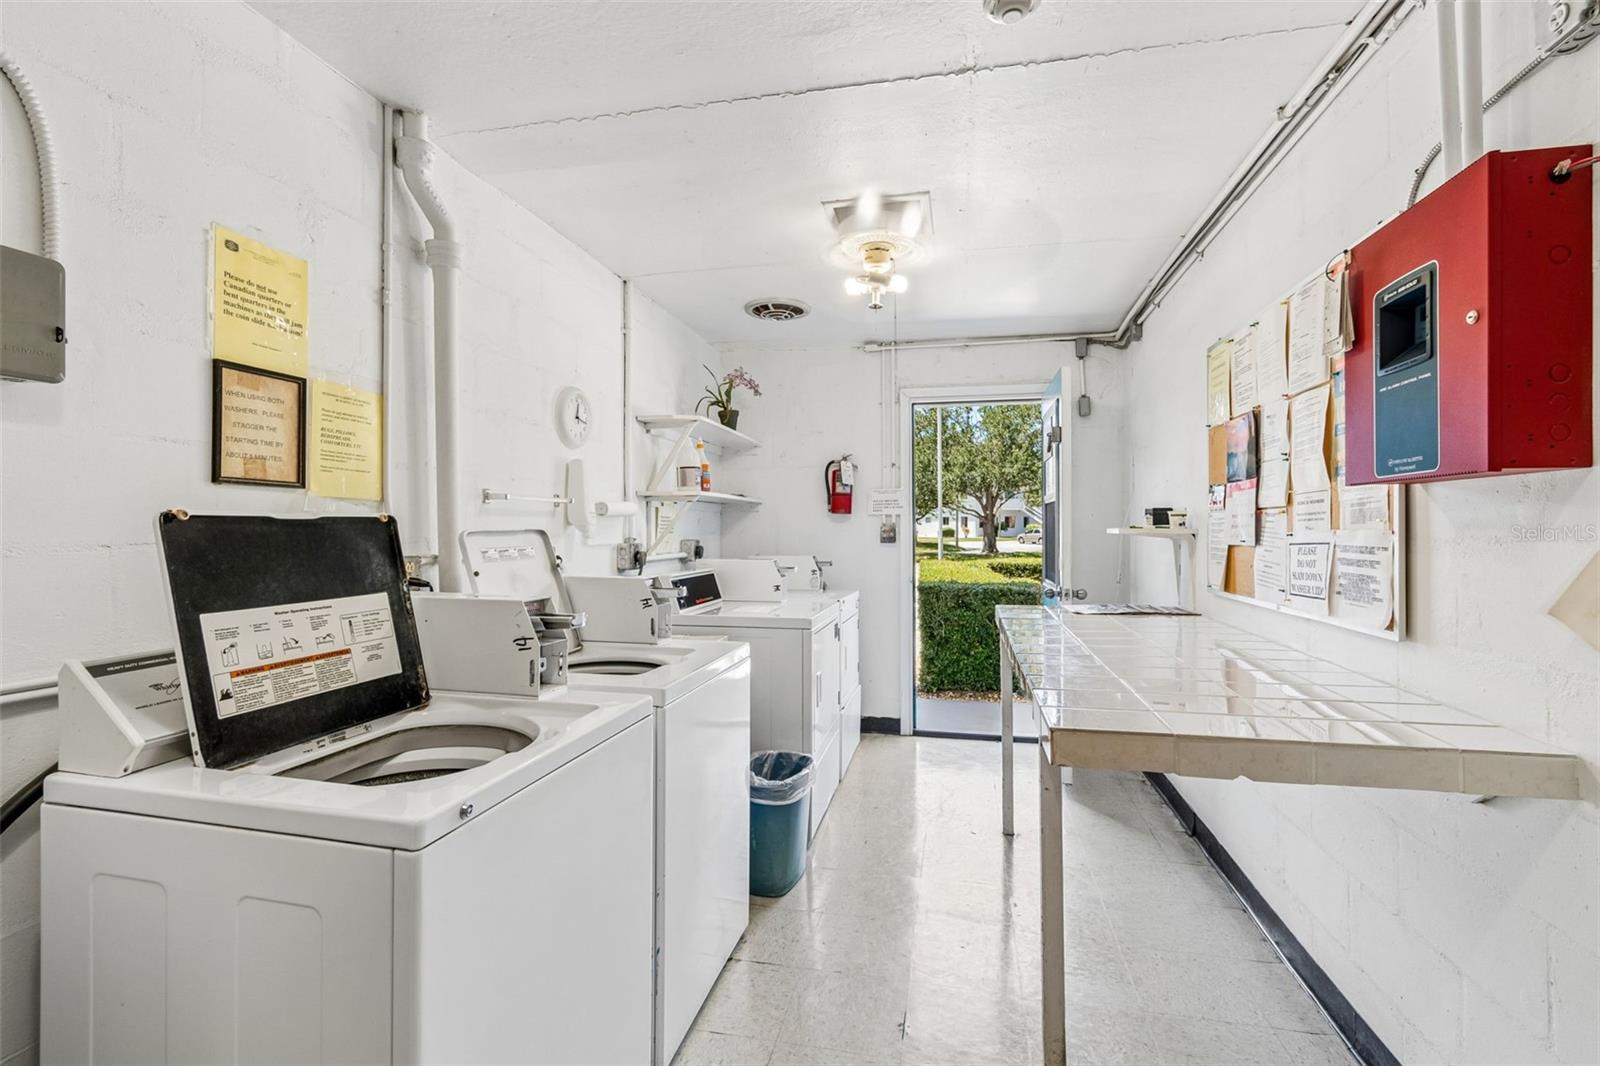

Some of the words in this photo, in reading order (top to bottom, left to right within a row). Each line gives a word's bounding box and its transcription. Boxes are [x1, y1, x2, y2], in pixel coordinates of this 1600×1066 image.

[224, 271, 244, 283] Please
[256, 284, 266, 292] not
[224, 280, 256, 296] Canadian
[258, 293, 284, 306] quarters
[224, 289, 239, 300] bent
[240, 296, 268, 309] quarters
[277, 306, 286, 315] the
[224, 300, 254, 314] machines
[264, 312, 276, 320] they
[291, 320, 304, 329] jam
[224, 308, 234, 317] the
[236, 313, 250, 322] coin
[251, 317, 266, 326] slide
[225, 390, 246, 399] WHEN
[247, 394, 266, 402] USING
[267, 397, 284, 405] BOTH
[262, 410, 284, 419] PLEASE
[232, 422, 264, 431] STAGGER
[226, 436, 258, 446] STARTING
[225, 451, 248, 459] ABOUT
[1298, 546, 1318, 556] PLEASE
[1296, 559, 1304, 568] DO
[1306, 560, 1317, 568] NOT
[1305, 572, 1322, 582] DOWN
